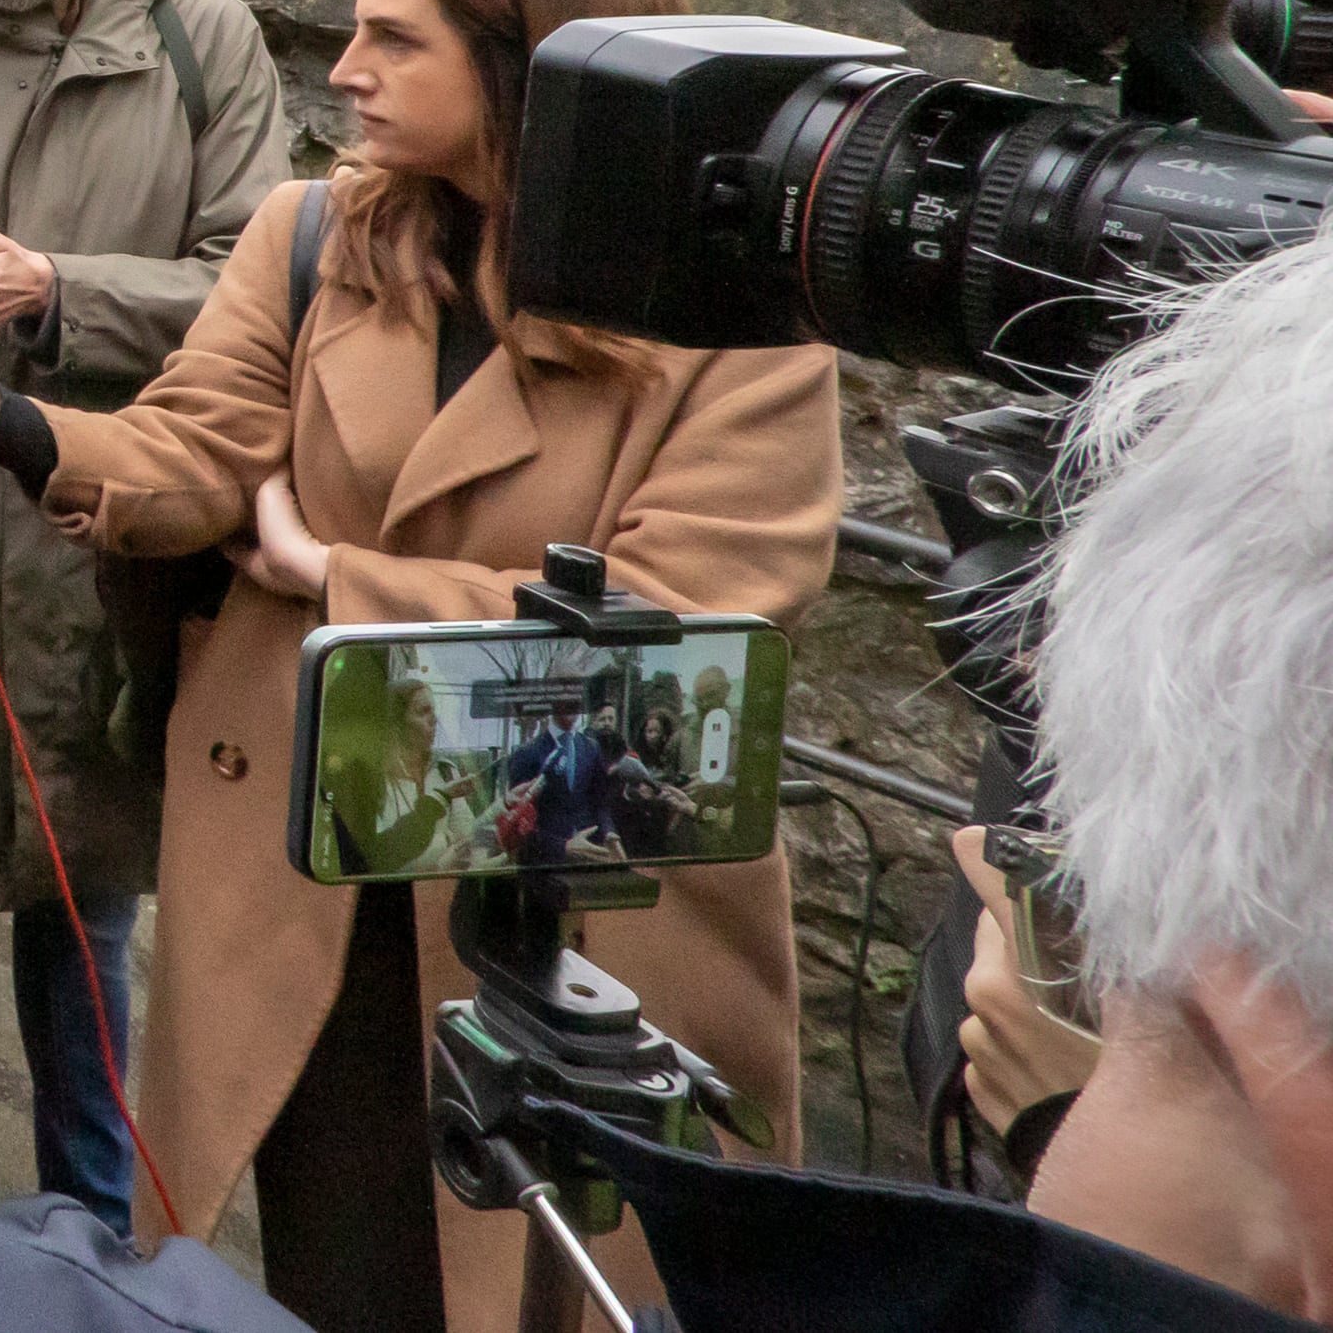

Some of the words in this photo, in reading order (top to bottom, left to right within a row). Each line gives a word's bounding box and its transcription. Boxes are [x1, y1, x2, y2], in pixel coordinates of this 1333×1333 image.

[1157, 158, 1238, 180] 4K
[786, 185, 799, 196] G
[782, 198, 797, 225] Lens
[779, 226, 793, 253] Sony
[1101, 227, 1145, 242] FILTER
